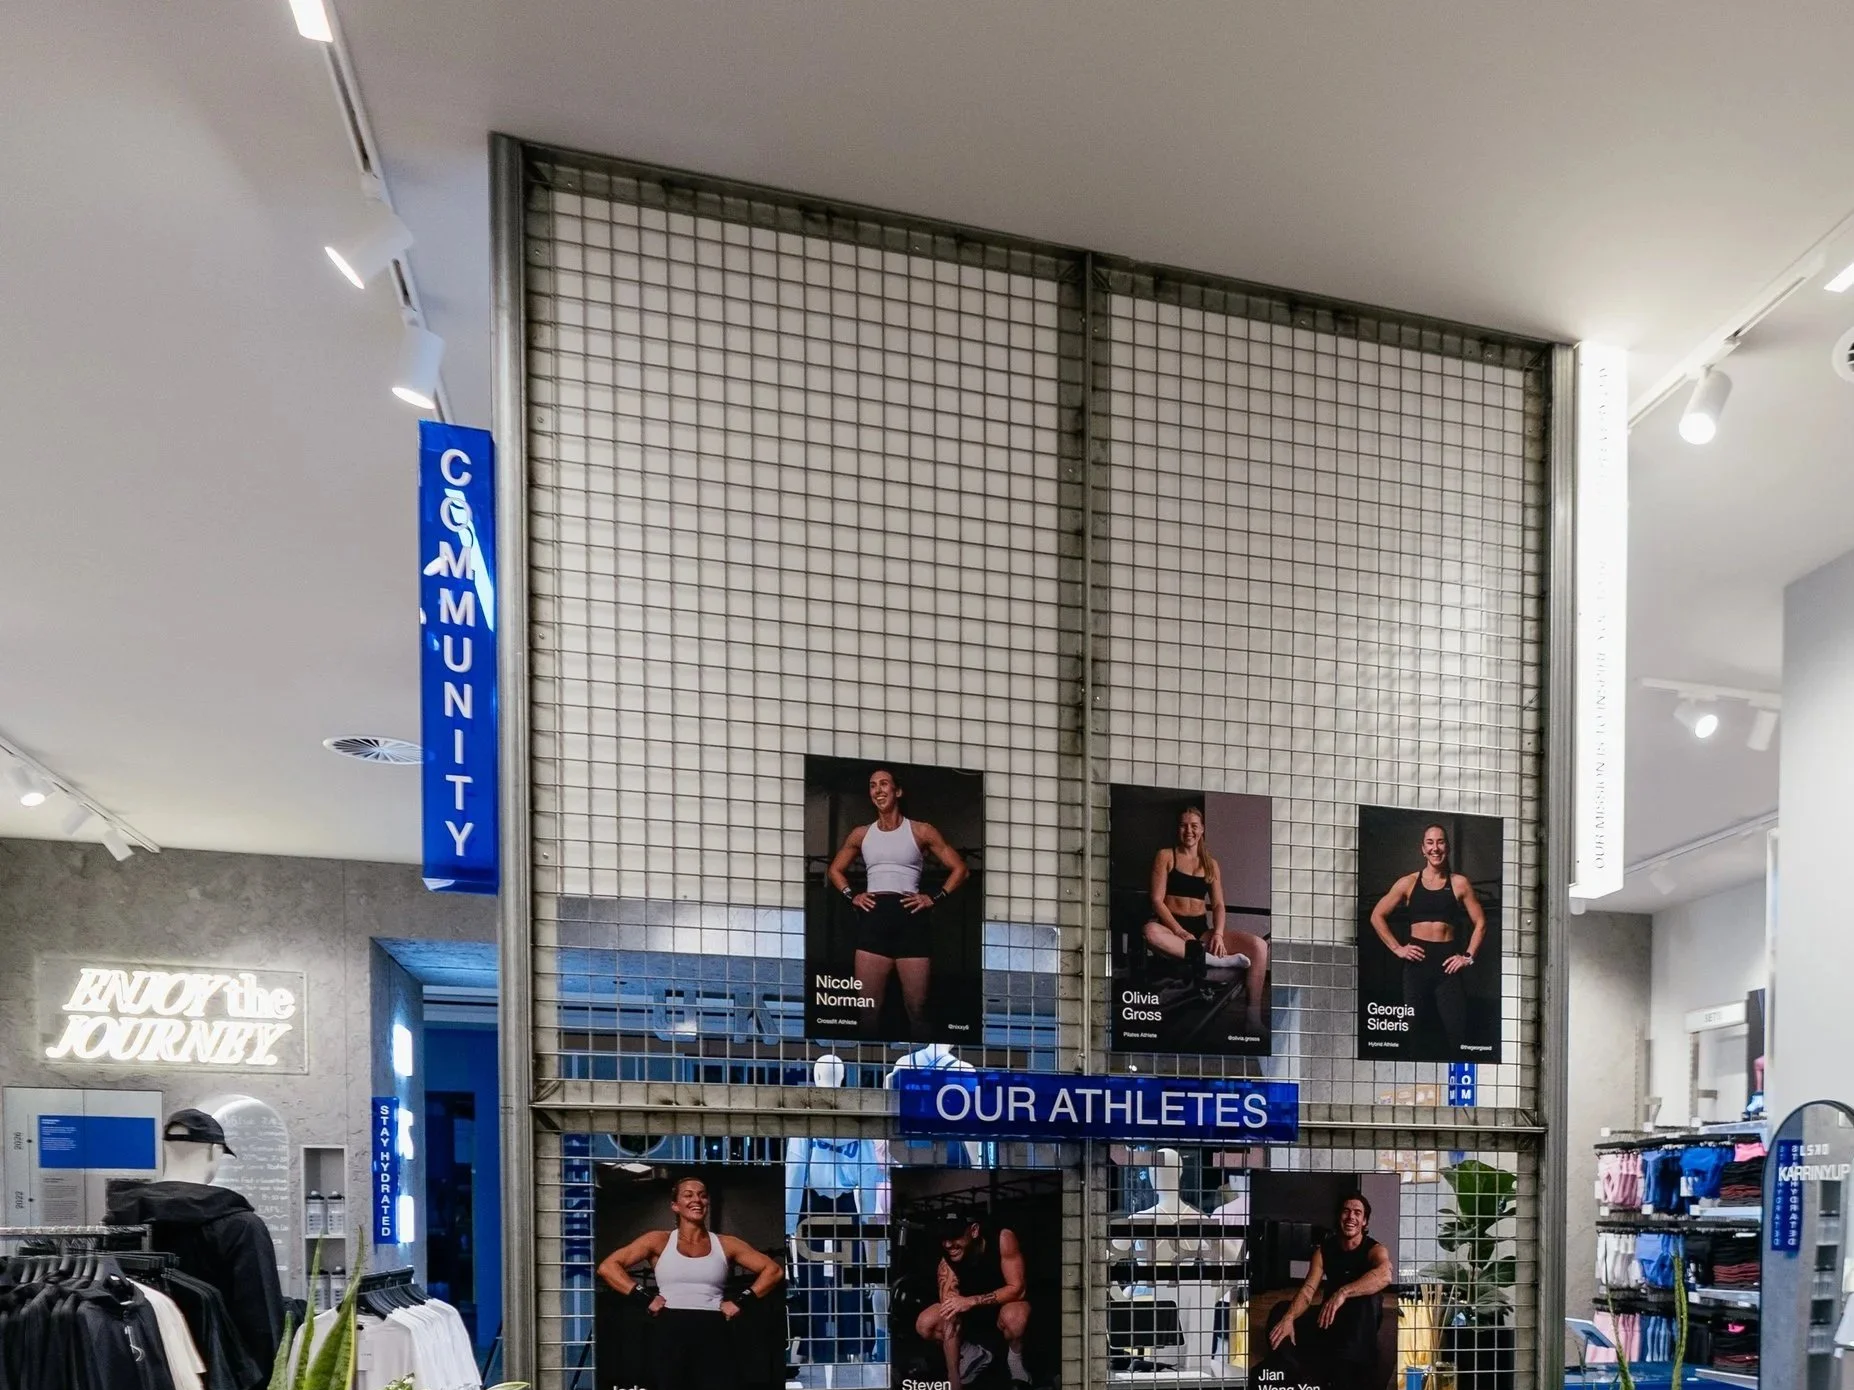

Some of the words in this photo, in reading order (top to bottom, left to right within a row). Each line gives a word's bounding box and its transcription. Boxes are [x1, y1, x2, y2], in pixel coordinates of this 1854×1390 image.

[438, 448, 476, 857] COMMUNITY
[1595, 834, 1605, 869] OUR
[816, 974, 862, 990] Nicole
[62, 968, 232, 1016] ENJOY
[224, 973, 296, 1020] the
[816, 992, 874, 1008] Norman
[1122, 991, 1159, 1005] Olivia
[1122, 1008, 1162, 1021] Gross
[1367, 1002, 1415, 1018] Georgia
[1367, 1018, 1409, 1032] Sideris
[46, 1014, 293, 1065] JOURNEY
[936, 1084, 1036, 1122] OUR
[1049, 1088, 1268, 1128] ATHLETES
[380, 1105, 390, 1147] STAY
[1778, 1164, 1850, 1181] KARRINYUP
[380, 1152, 390, 1236] HYDRATED
[1258, 1369, 1284, 1381] Jian
